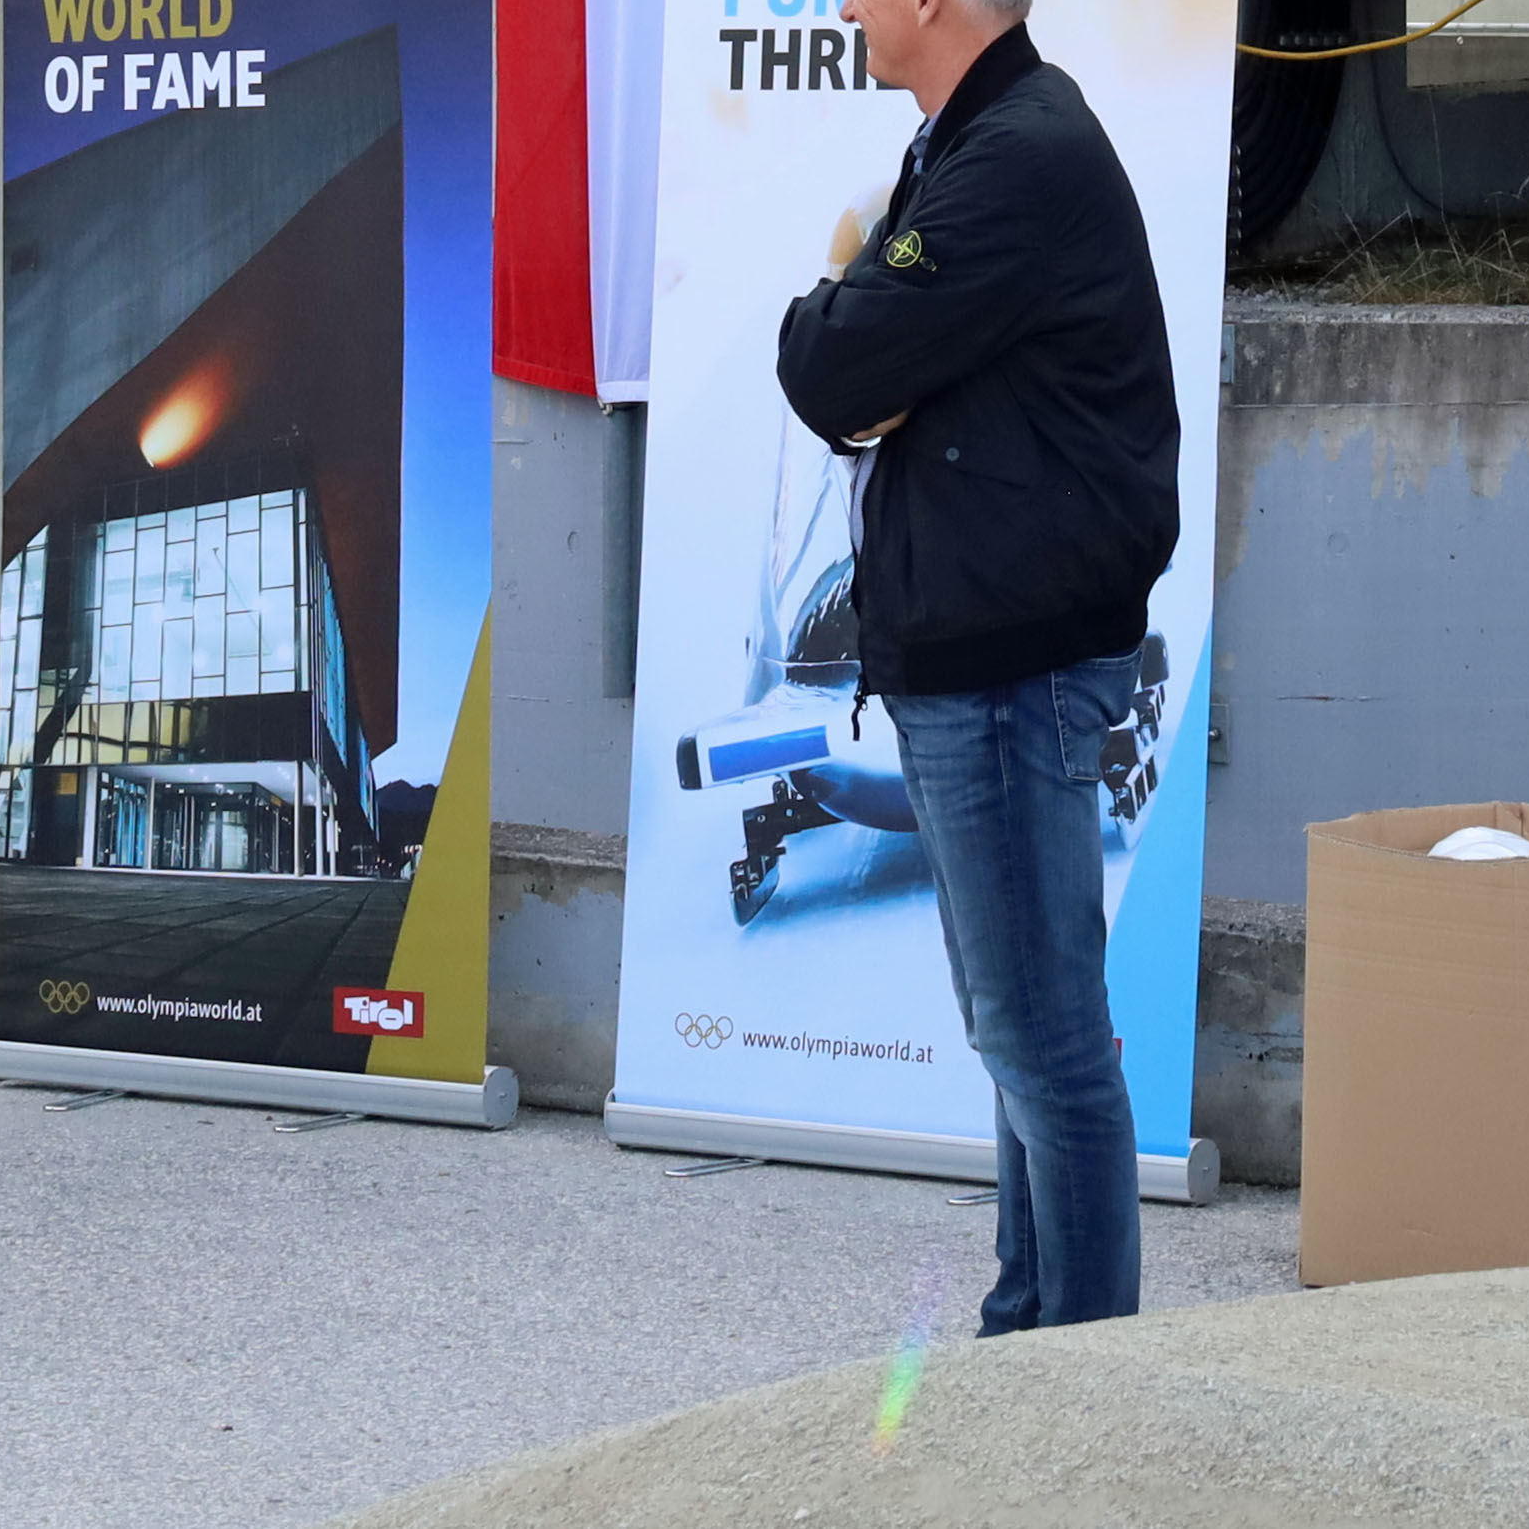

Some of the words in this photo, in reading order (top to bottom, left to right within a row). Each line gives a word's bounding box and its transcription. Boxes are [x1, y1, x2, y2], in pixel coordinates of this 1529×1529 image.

[719, 28, 905, 91] THRI
[44, 54, 108, 114] OF
[124, 49, 266, 111] FAME
[96, 993, 263, 1023] www.olympiaworld.at
[343, 995, 414, 1030] Tirol
[742, 1028, 933, 1064] www.olympiaworld.at
